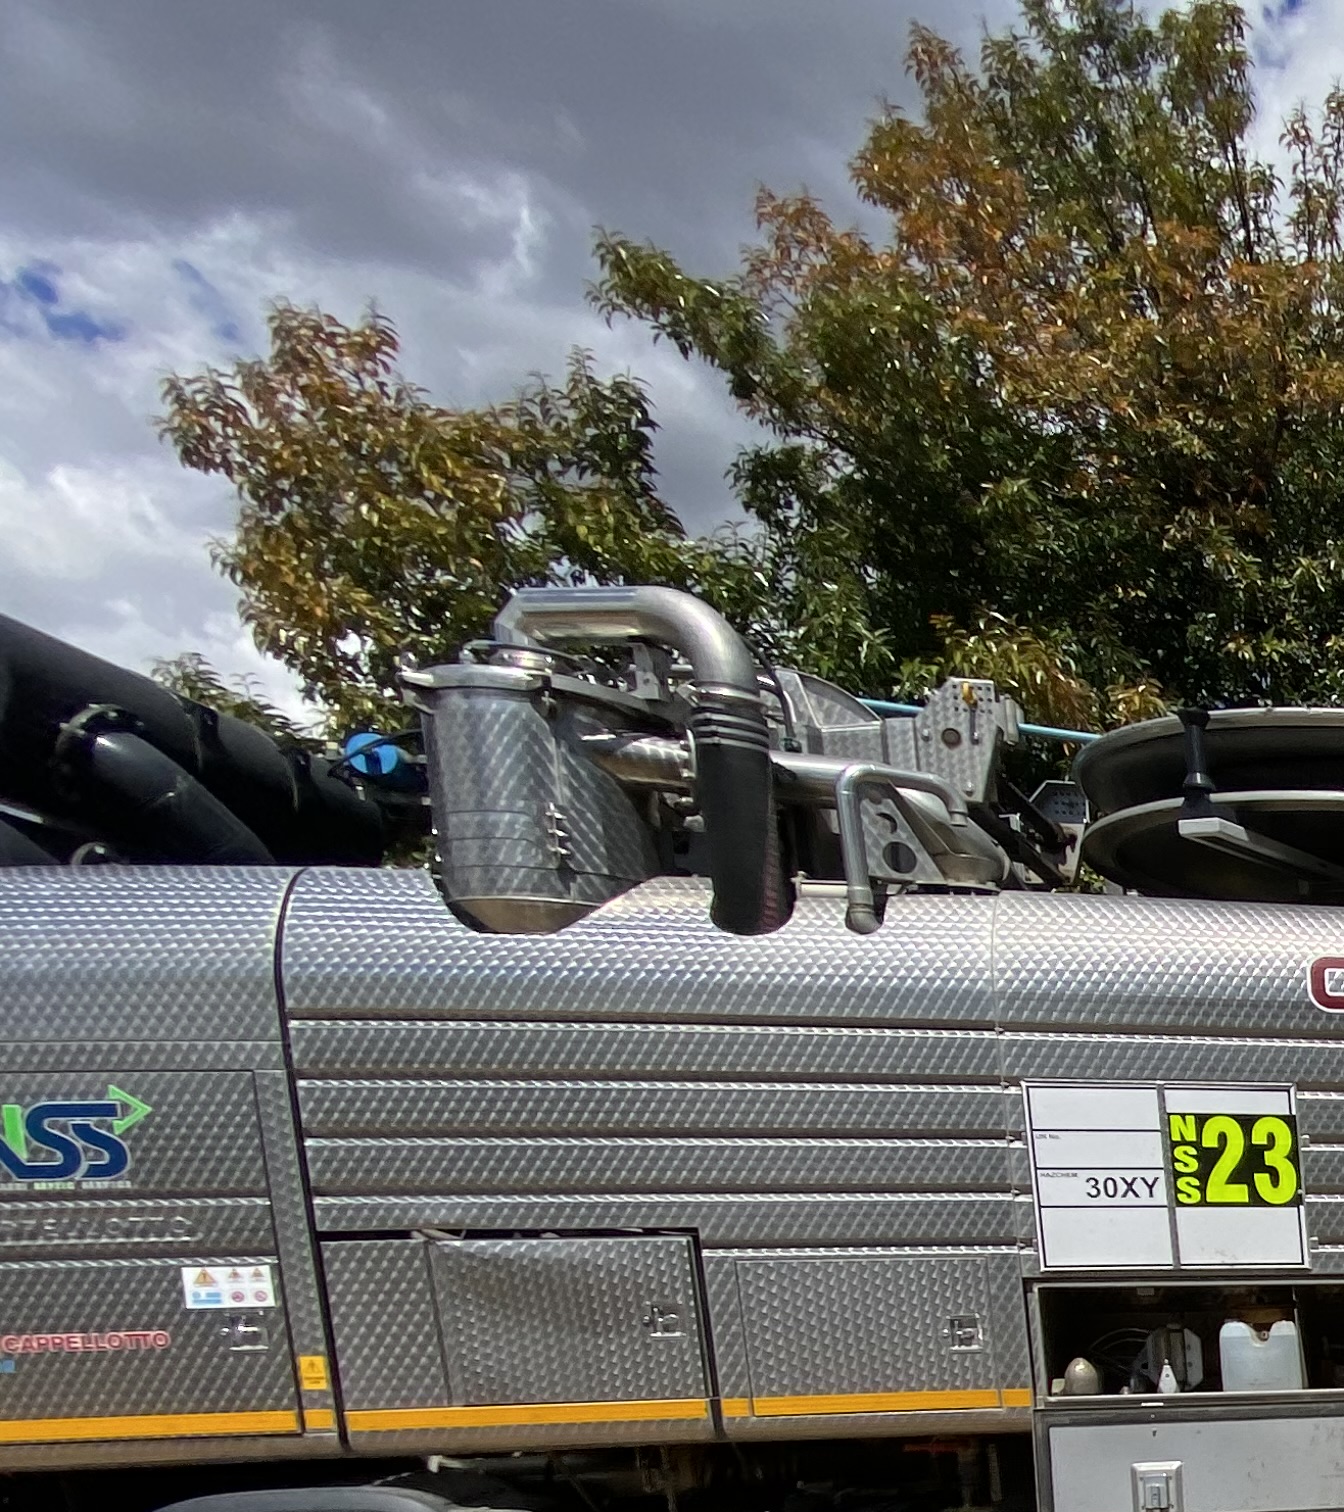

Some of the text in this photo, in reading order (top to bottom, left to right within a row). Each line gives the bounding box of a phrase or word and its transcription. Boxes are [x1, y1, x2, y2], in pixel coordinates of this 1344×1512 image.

[1201, 1115, 1297, 1205] 23
[1085, 1176, 1160, 1199] 30XY
[2, 1331, 170, 1353] CAPPELLOTTO
